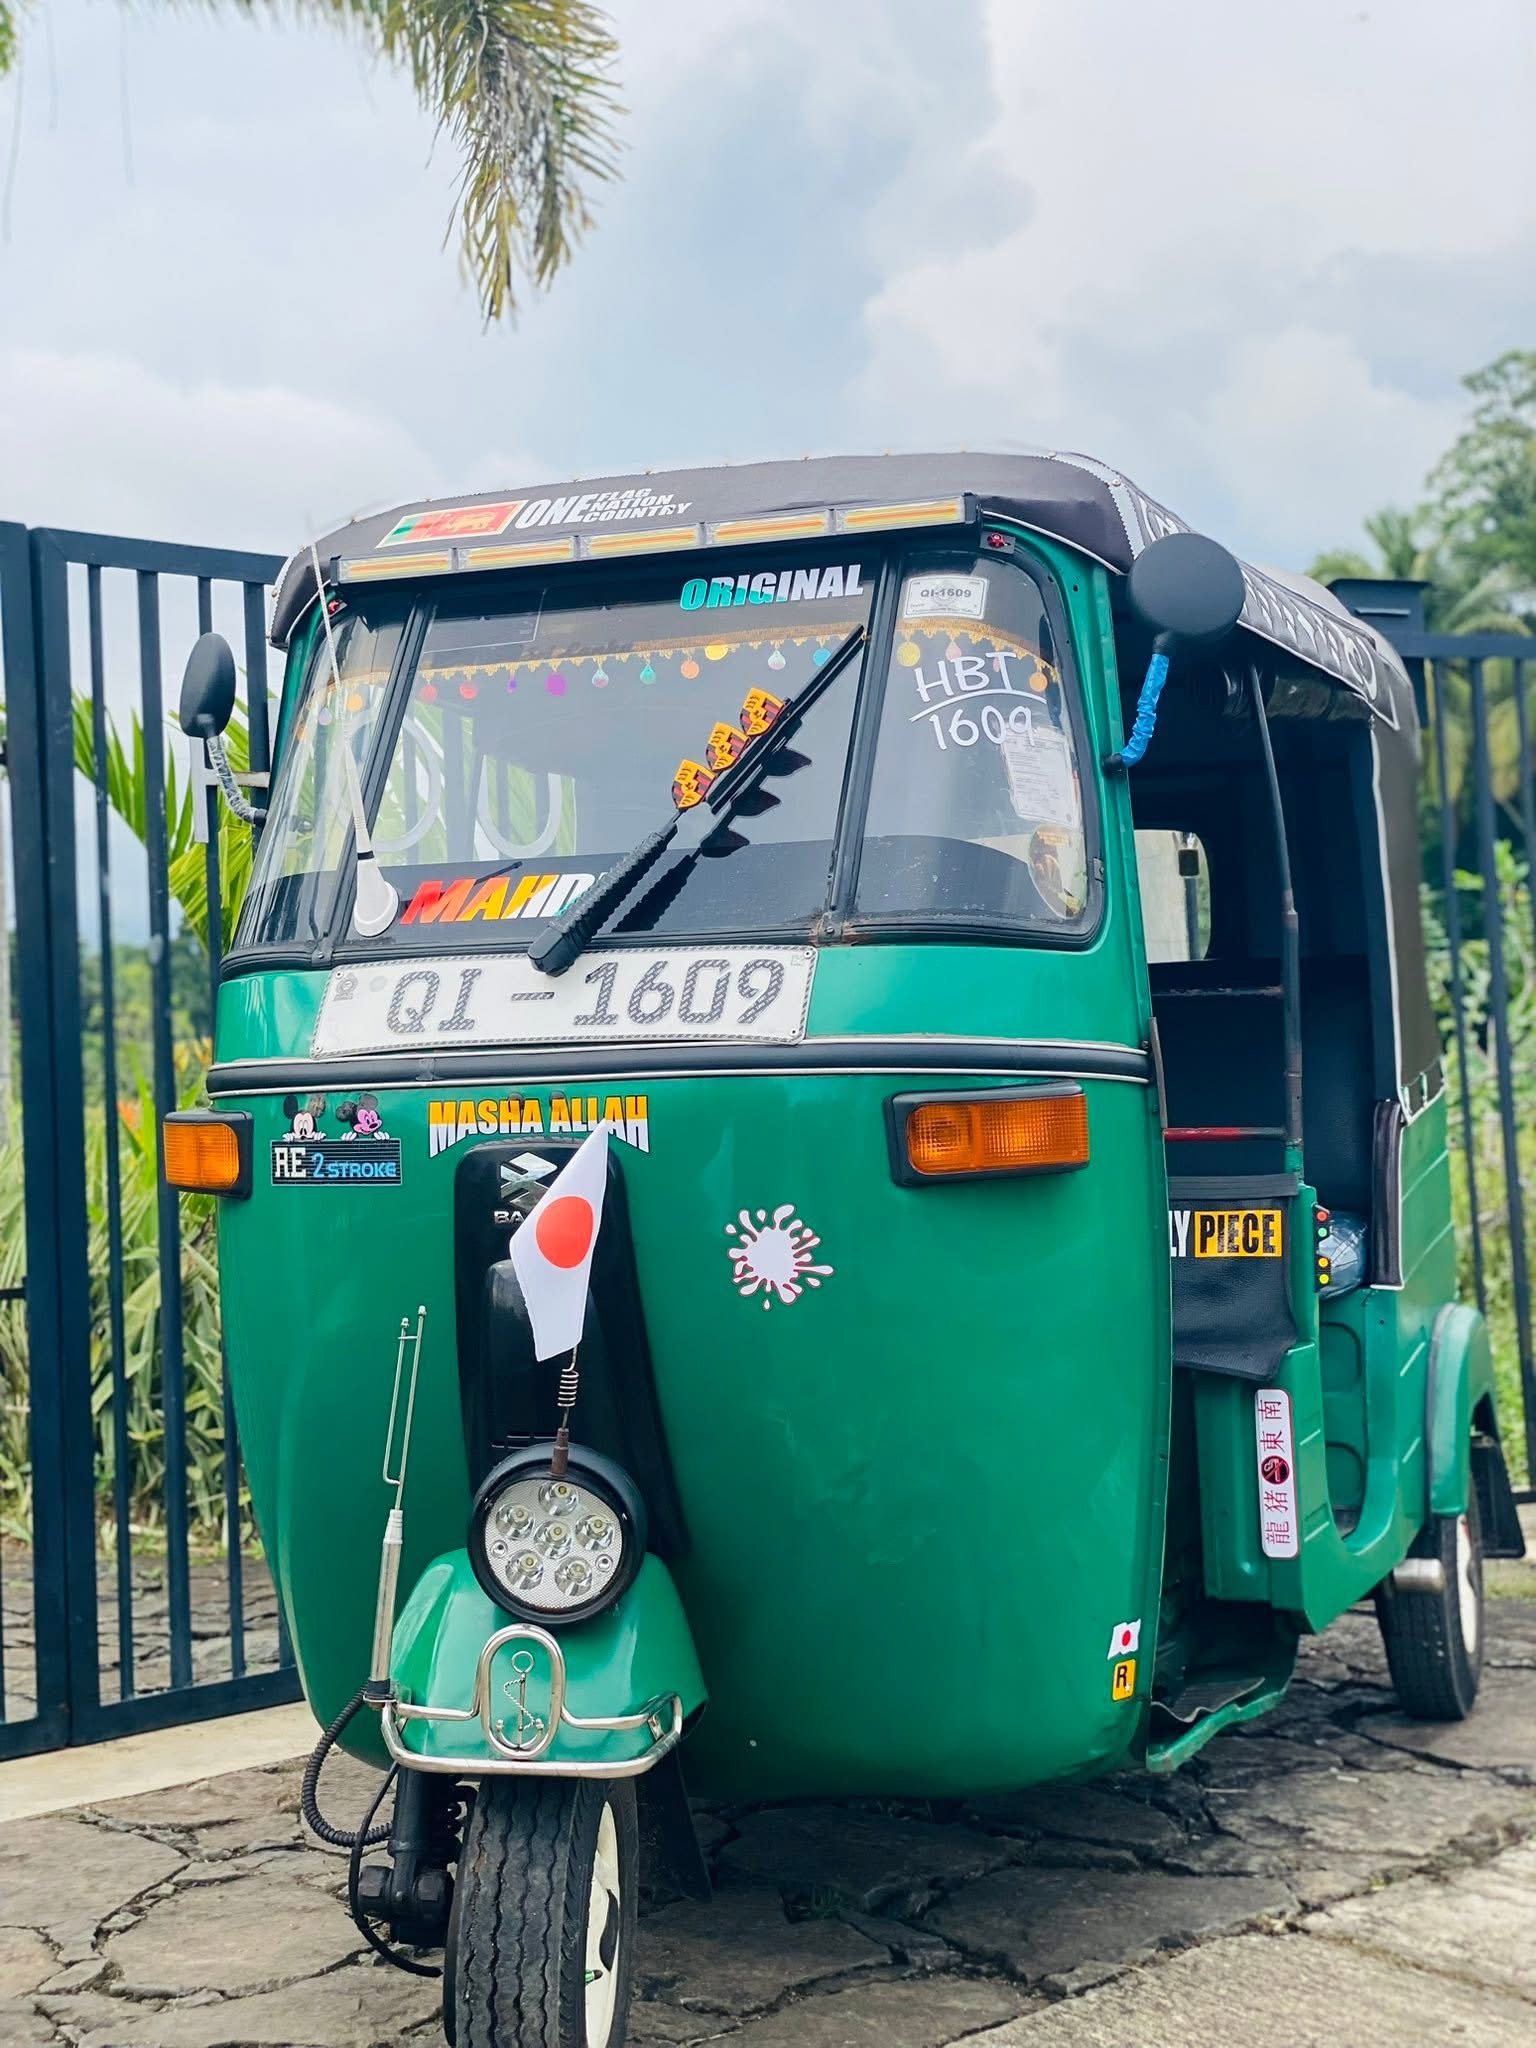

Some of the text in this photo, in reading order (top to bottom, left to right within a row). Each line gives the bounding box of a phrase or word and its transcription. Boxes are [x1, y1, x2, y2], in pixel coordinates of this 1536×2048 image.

[515, 494, 599, 529] ONE
[582, 502, 693, 523] COUNTRY
[591, 494, 674, 512] NATION
[596, 488, 652, 501] FLAG
[679, 563, 864, 611] ORIGINAL
[920, 588, 972, 598] QI-1609
[914, 652, 1017, 702] HBT
[929, 705, 1035, 750] 1609
[400, 872, 607, 925] MAHD
[386, 968, 483, 1033] QI
[573, 958, 785, 1028] 1609
[429, 1095, 650, 1159] MASHA ALLAH
[274, 1147, 307, 1178] RE
[1200, 1213, 1276, 1254] PIECE
[1116, 1665, 1128, 1689] R
